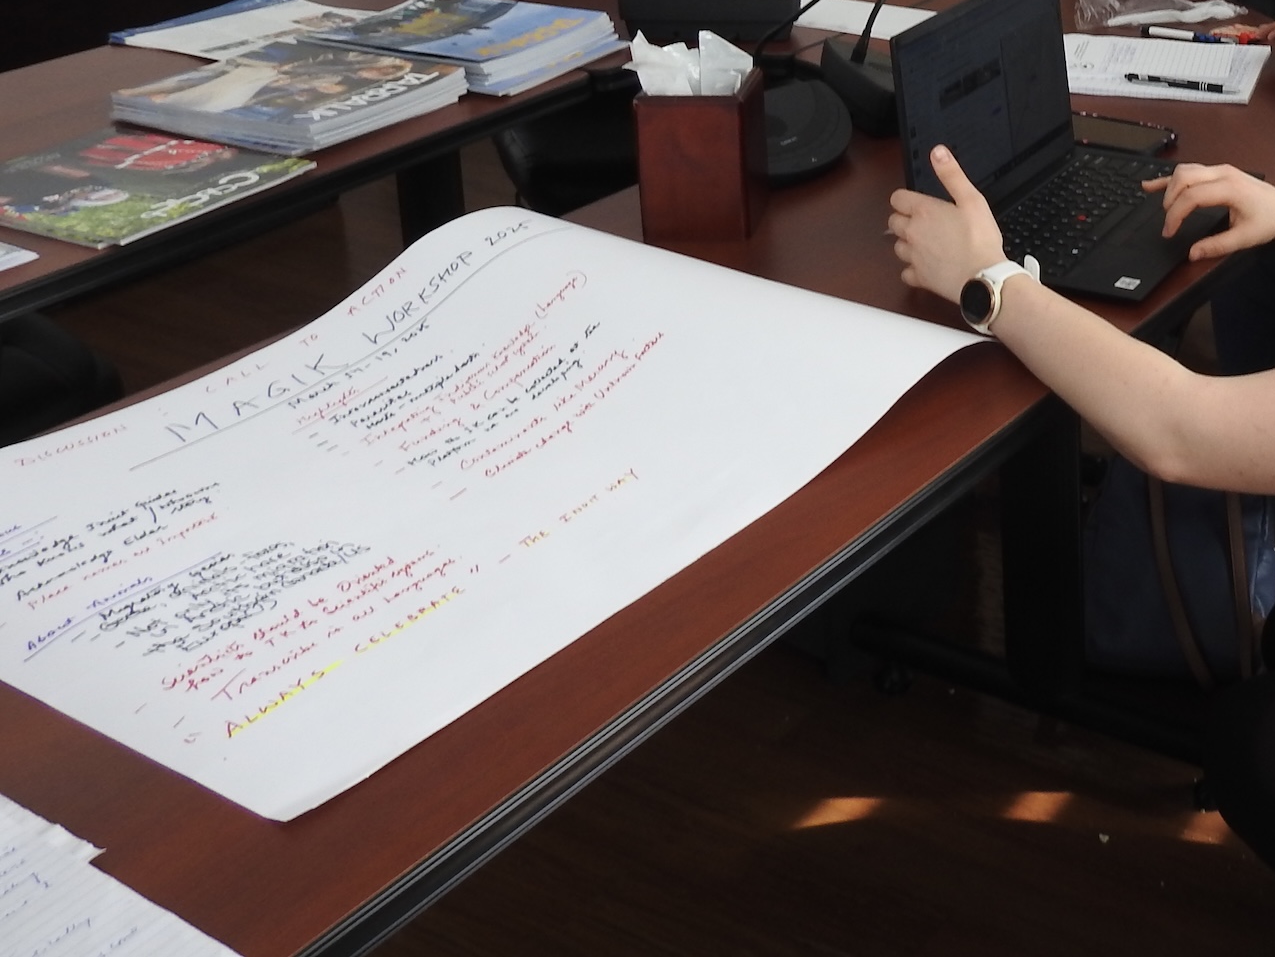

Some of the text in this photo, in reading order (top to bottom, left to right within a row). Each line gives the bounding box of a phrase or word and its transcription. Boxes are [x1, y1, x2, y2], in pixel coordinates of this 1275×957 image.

[165, 353, 349, 442] MAGIK
[362, 250, 473, 345] WORKSHOP
[205, 362, 268, 393] CALL
[300, 333, 318, 347] TO
[348, 267, 407, 317] ACTION
[225, 668, 326, 738] ALWAYS
[355, 585, 466, 653] CELEBRATE
[519, 529, 550, 548] THE
[605, 468, 639, 492] WAY
